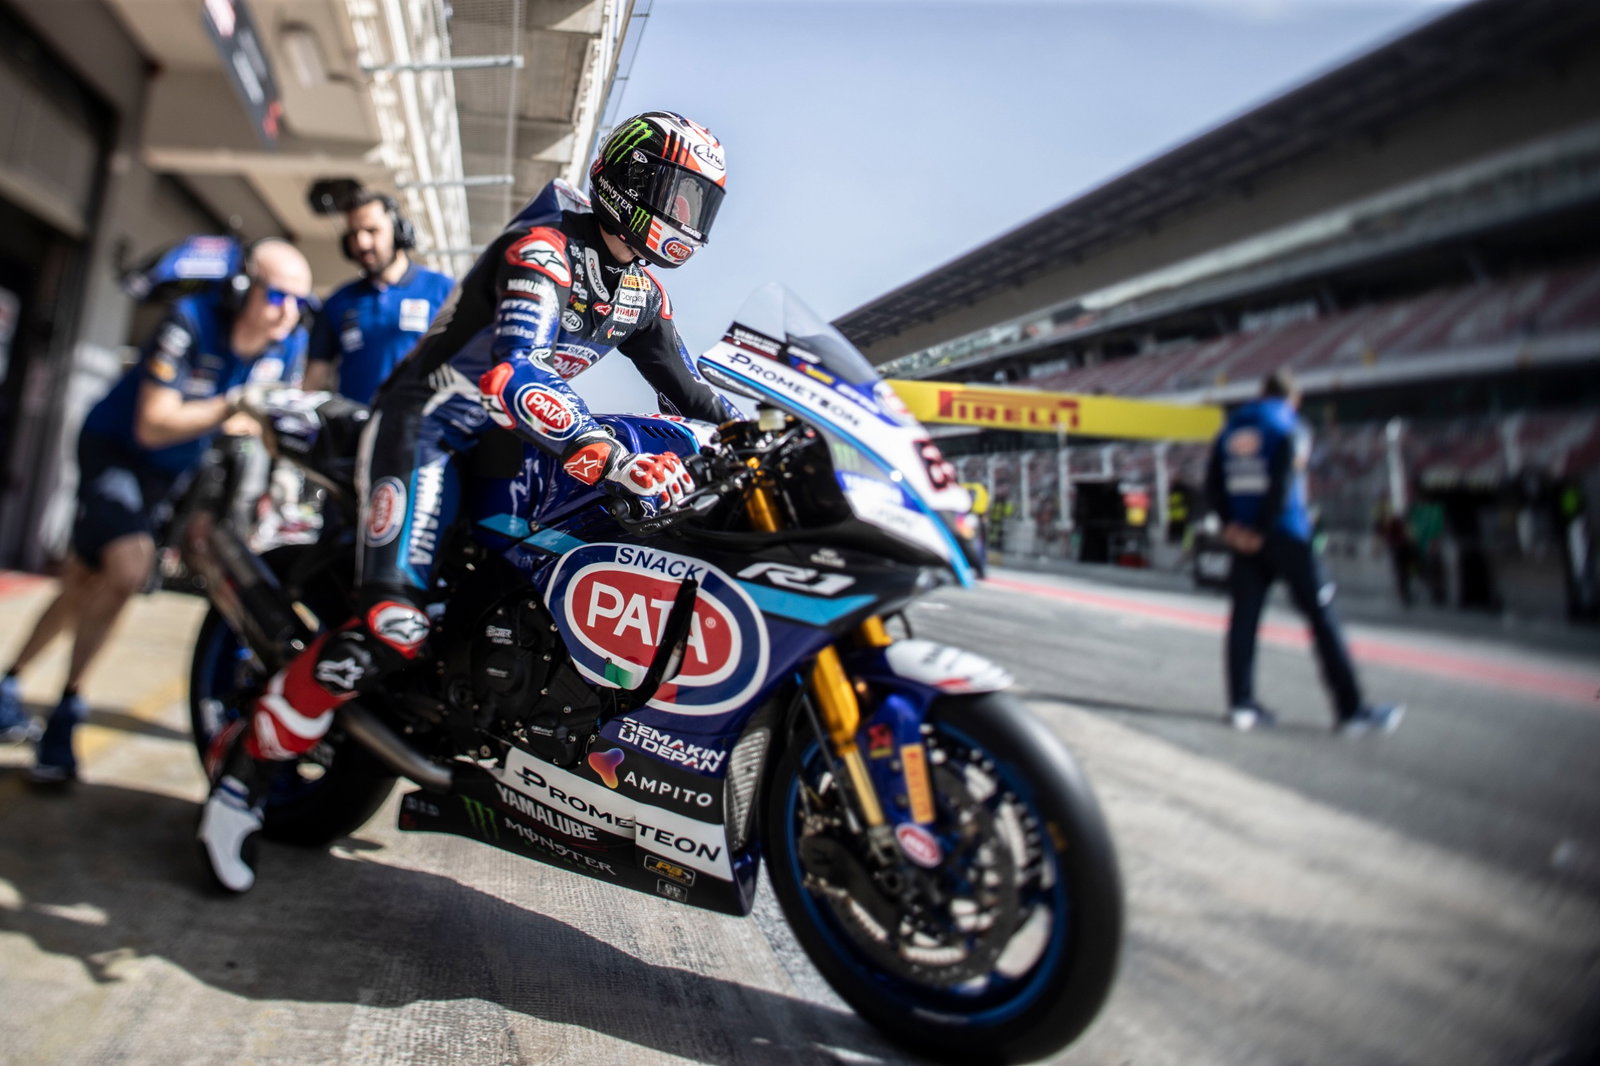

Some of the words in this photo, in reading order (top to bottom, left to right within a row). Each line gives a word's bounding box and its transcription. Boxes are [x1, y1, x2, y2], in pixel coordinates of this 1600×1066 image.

[598, 175, 634, 215] MONSTER
[668, 243, 690, 258] PATA
[589, 257, 607, 295] CRESCENT
[527, 392, 565, 428] PATA
[938, 390, 1080, 427] PIRELLI
[617, 547, 703, 581] SNACK
[586, 580, 709, 665] PATA
[622, 716, 727, 762] SEMAKIN
[641, 738, 721, 773] DEPAN
[624, 770, 713, 807] AMPITO
[495, 782, 599, 842] YAMALUBE
[514, 766, 722, 862] PROMETEON
[504, 817, 617, 876] MONSTER
